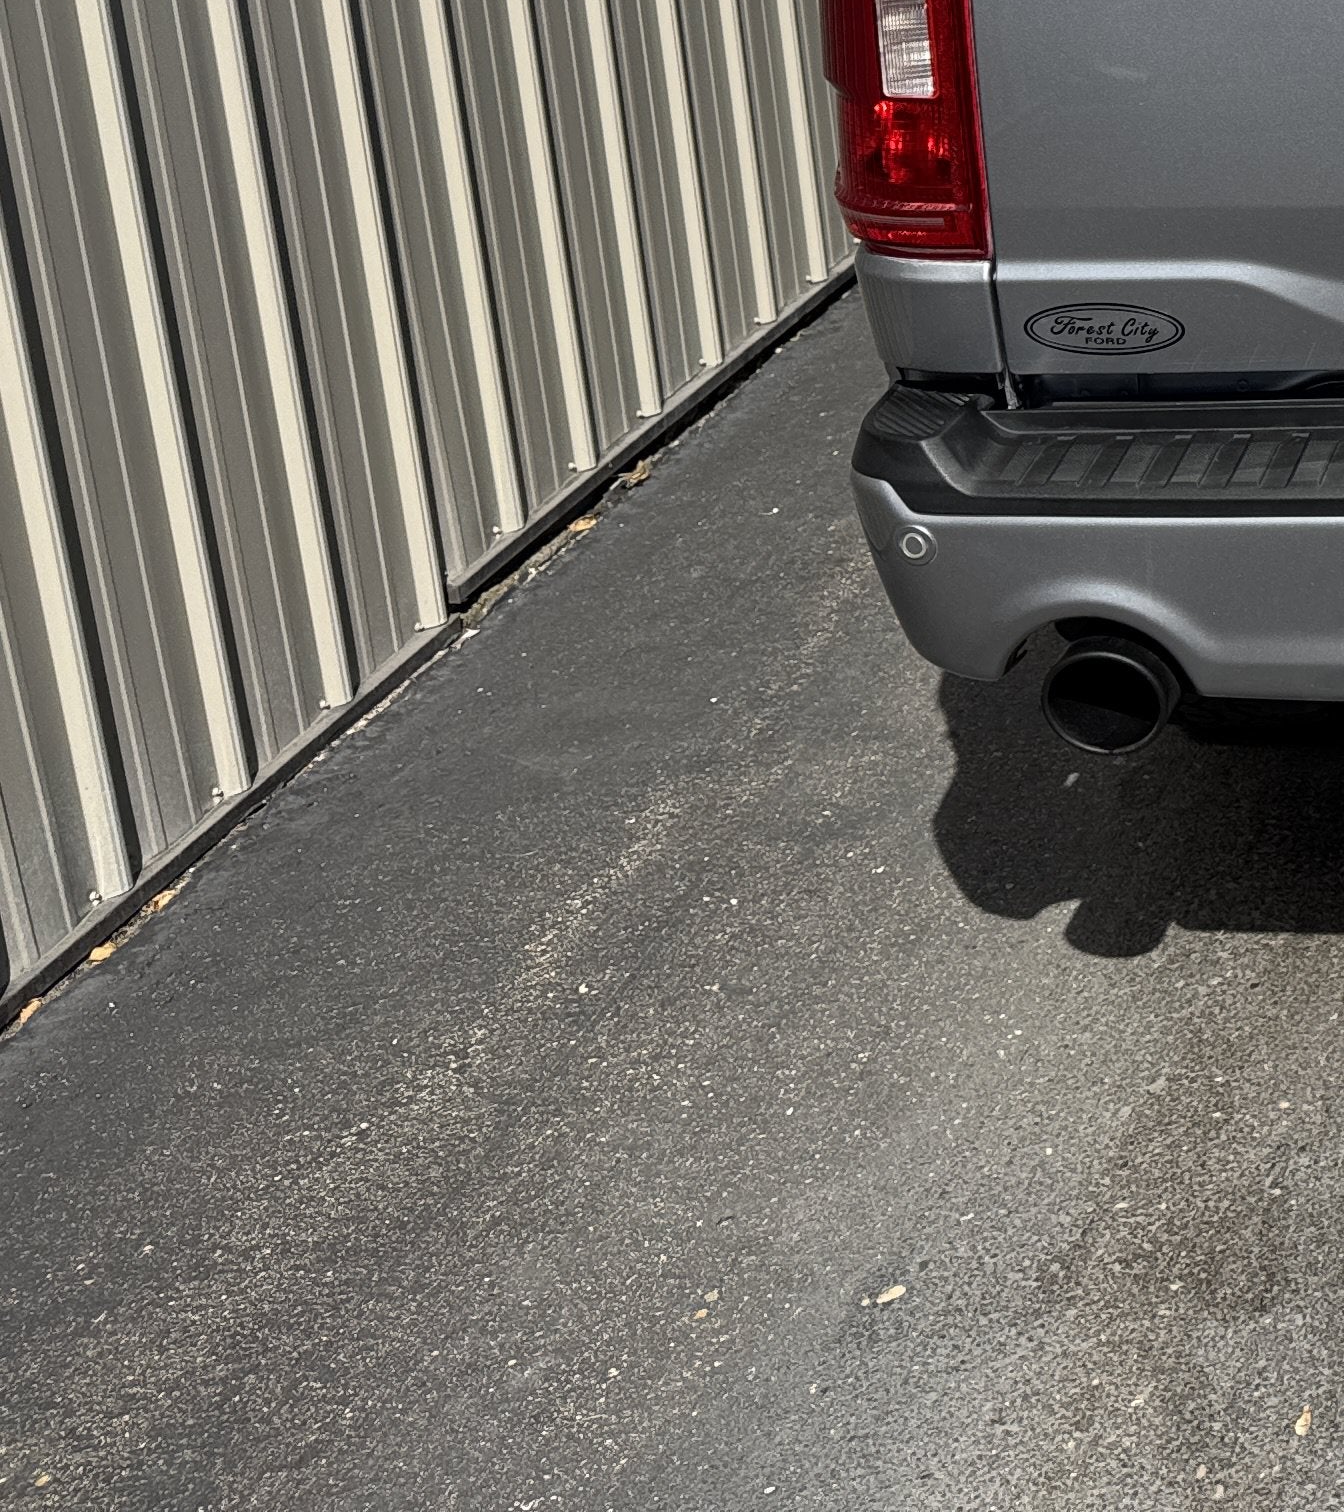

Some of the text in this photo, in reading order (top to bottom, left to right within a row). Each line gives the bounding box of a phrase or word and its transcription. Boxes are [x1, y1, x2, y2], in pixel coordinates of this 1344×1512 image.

[1050, 315, 1160, 343] Forest City
[1085, 336, 1127, 346] FORD
